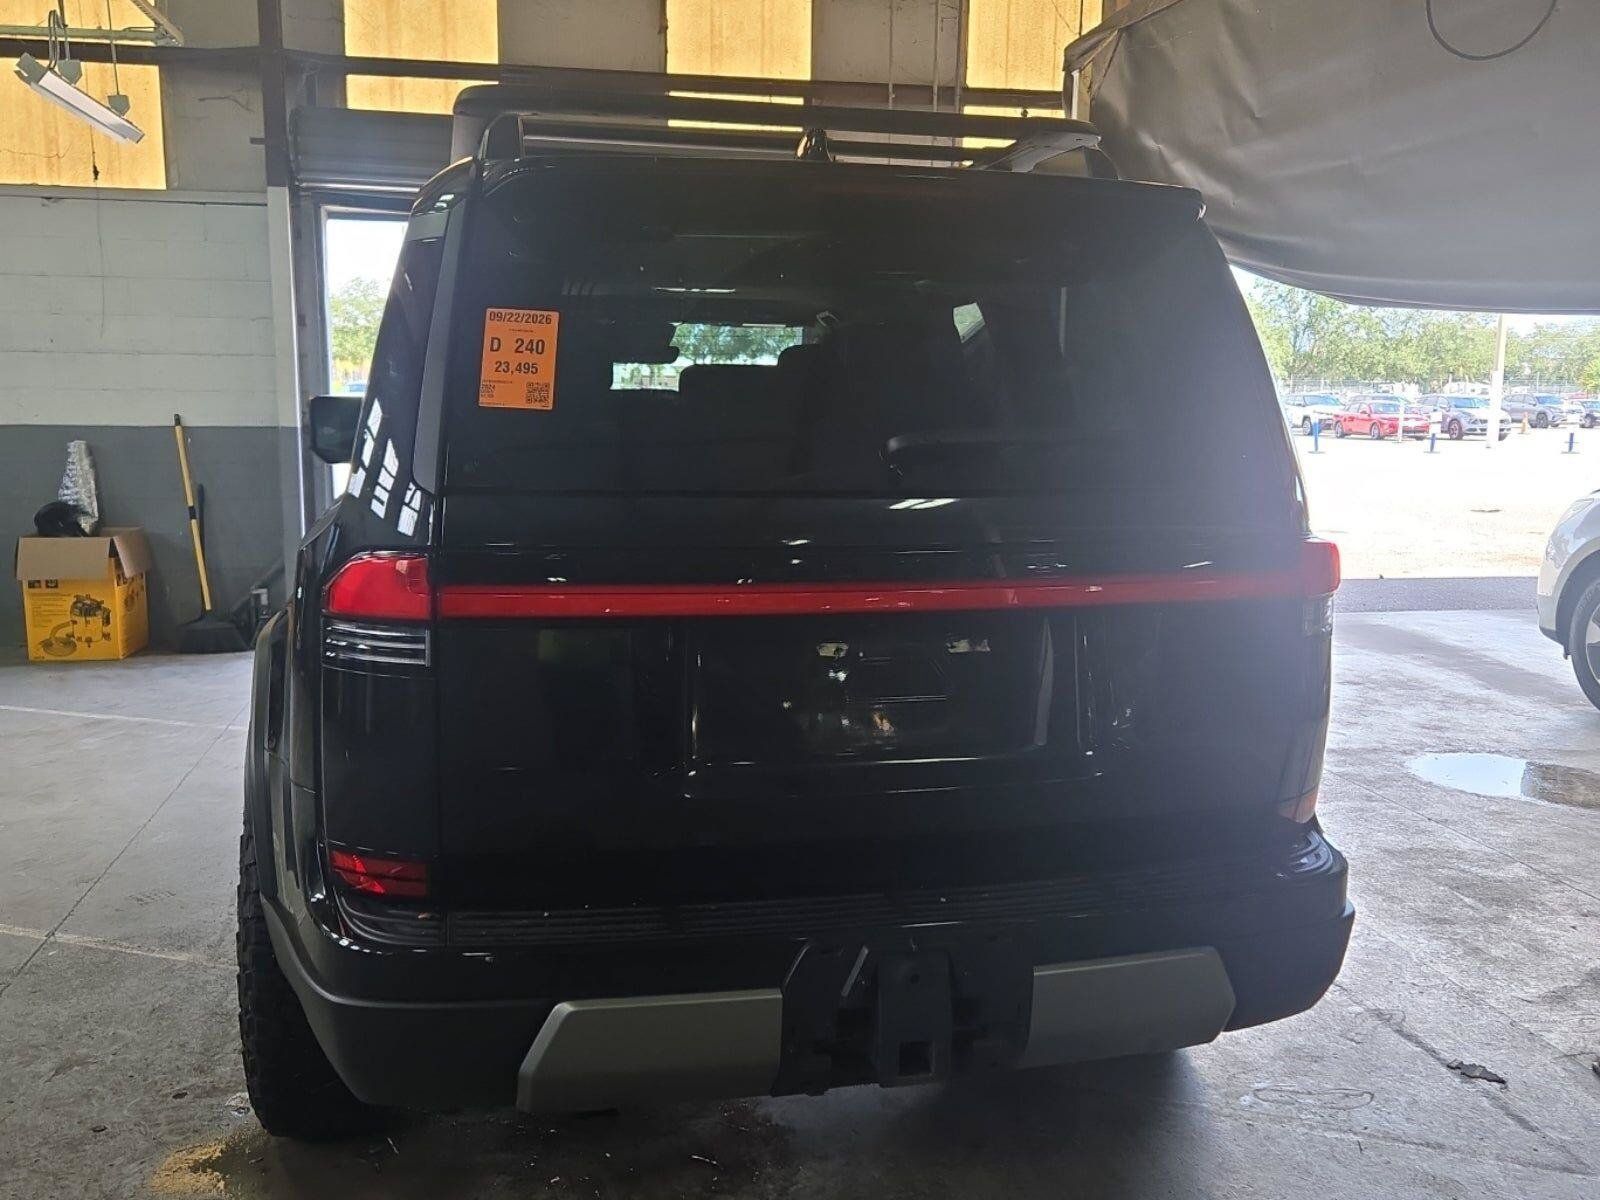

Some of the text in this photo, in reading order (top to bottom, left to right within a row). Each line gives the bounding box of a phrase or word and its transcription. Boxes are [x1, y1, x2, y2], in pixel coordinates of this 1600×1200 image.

[489, 311, 552, 324] 09/22/2026
[490, 337, 546, 355] D 240
[495, 361, 538, 375] 23,495
